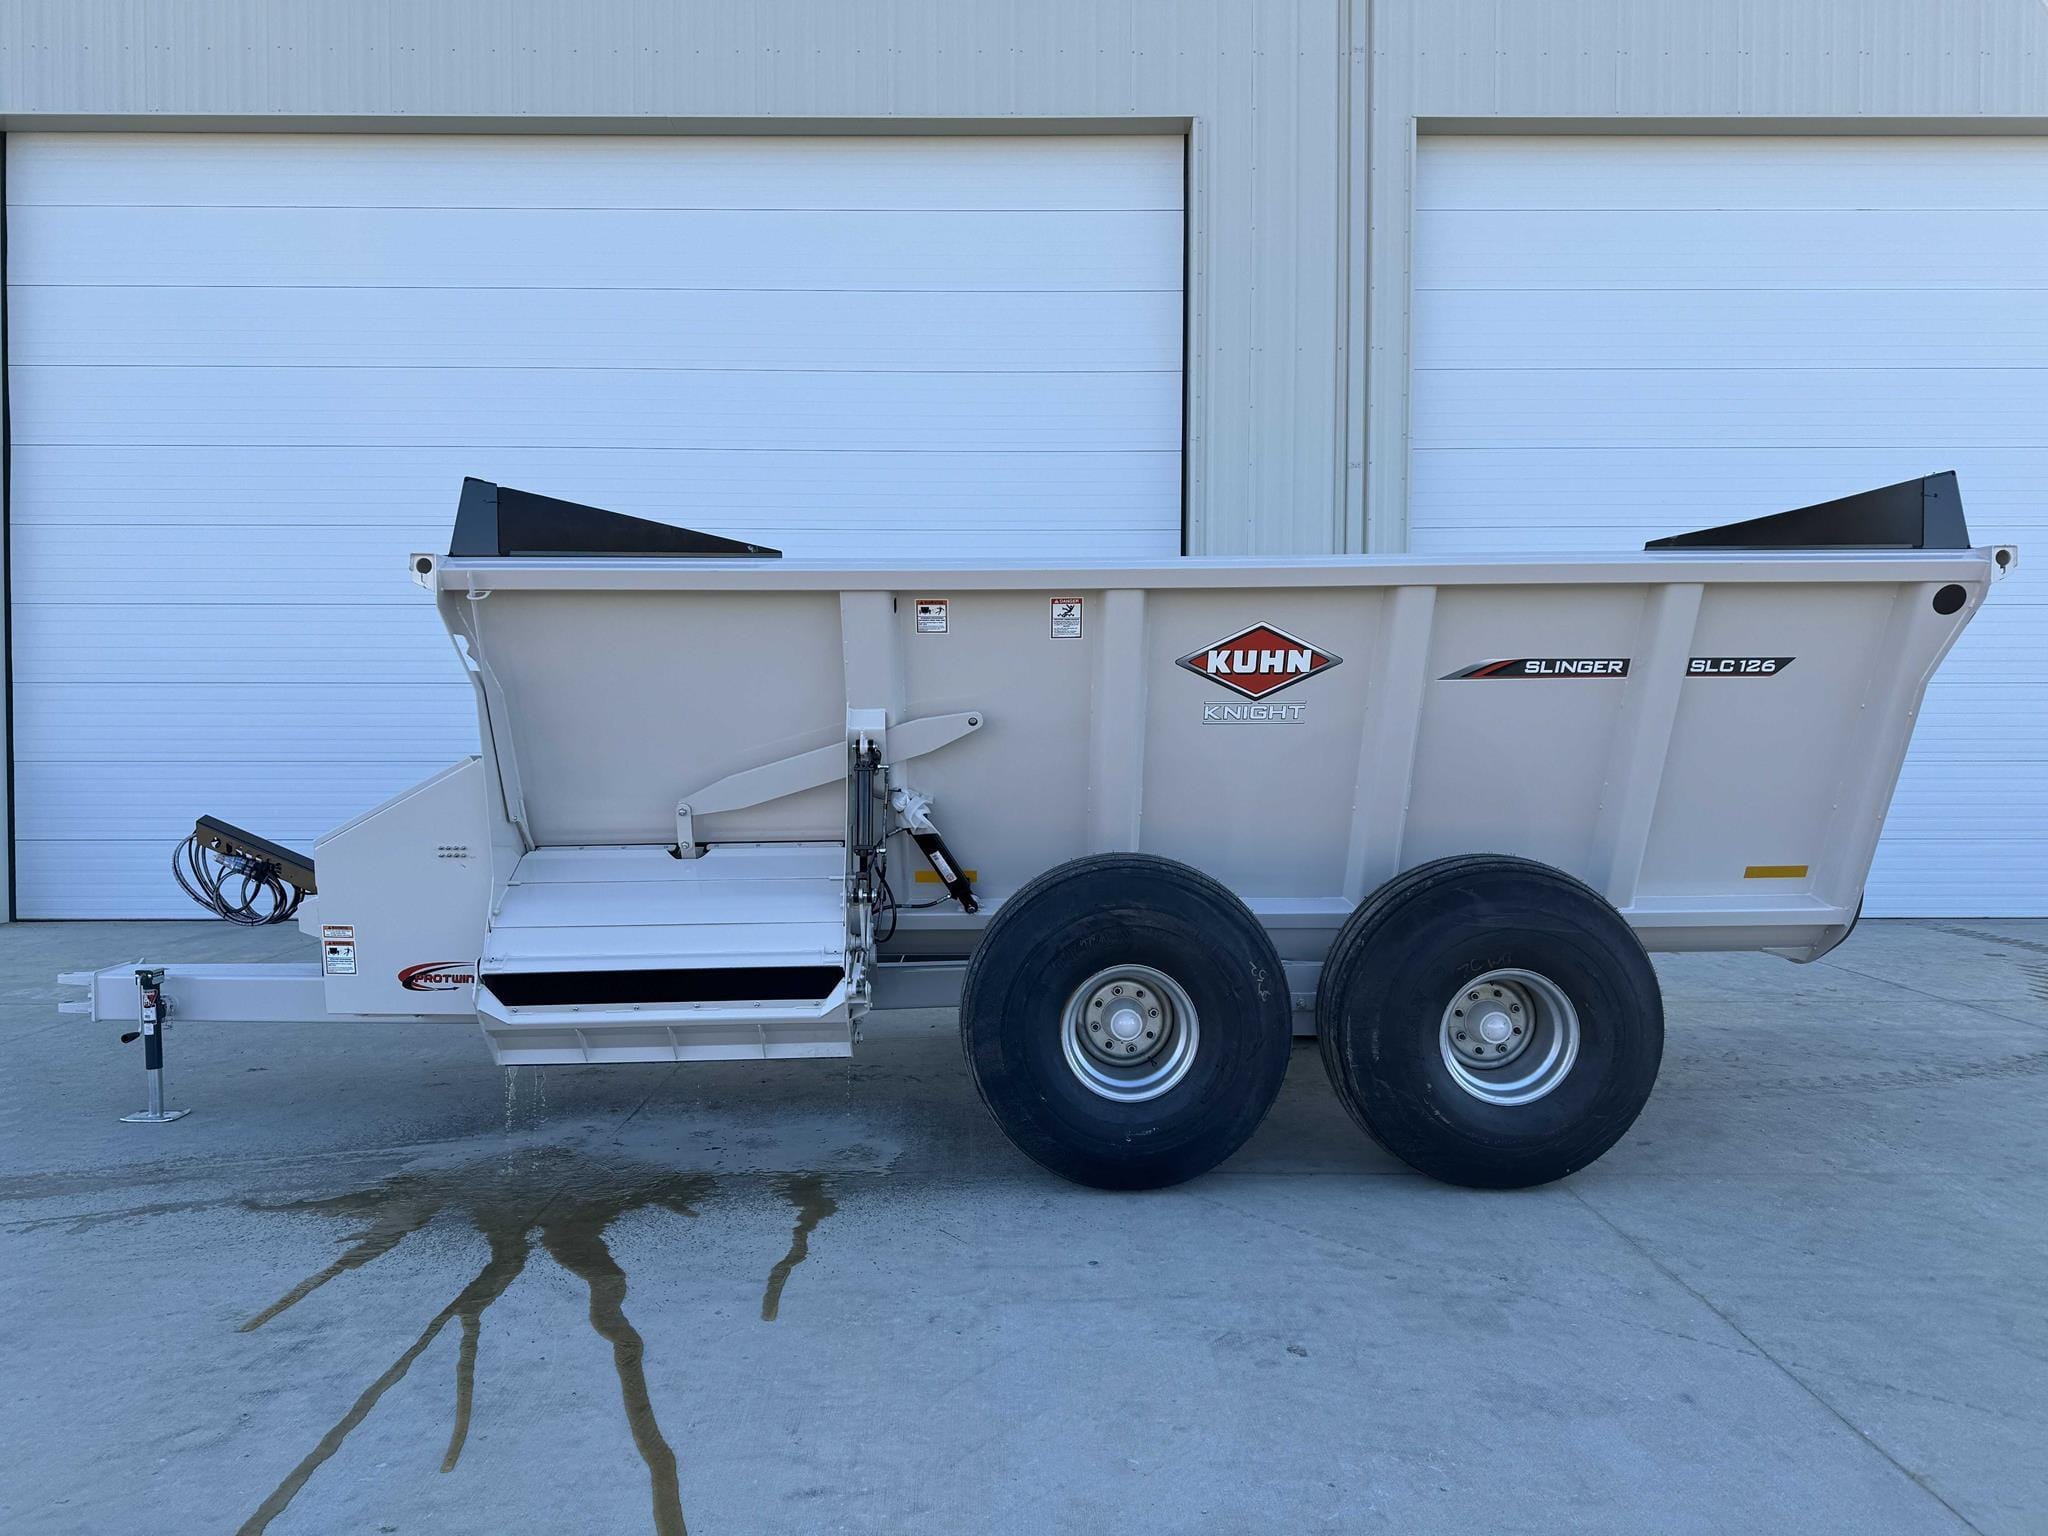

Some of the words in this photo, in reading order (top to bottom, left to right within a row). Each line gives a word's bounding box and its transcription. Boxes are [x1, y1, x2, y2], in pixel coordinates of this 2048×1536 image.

[1206, 649, 1312, 674] KUHN
[1524, 660, 1624, 674] SLINGER
[1690, 659, 1735, 672] SLC
[1739, 659, 1776, 672] 126
[1203, 705, 1306, 721] KNIGHT
[414, 973, 475, 984] PROTWIN
